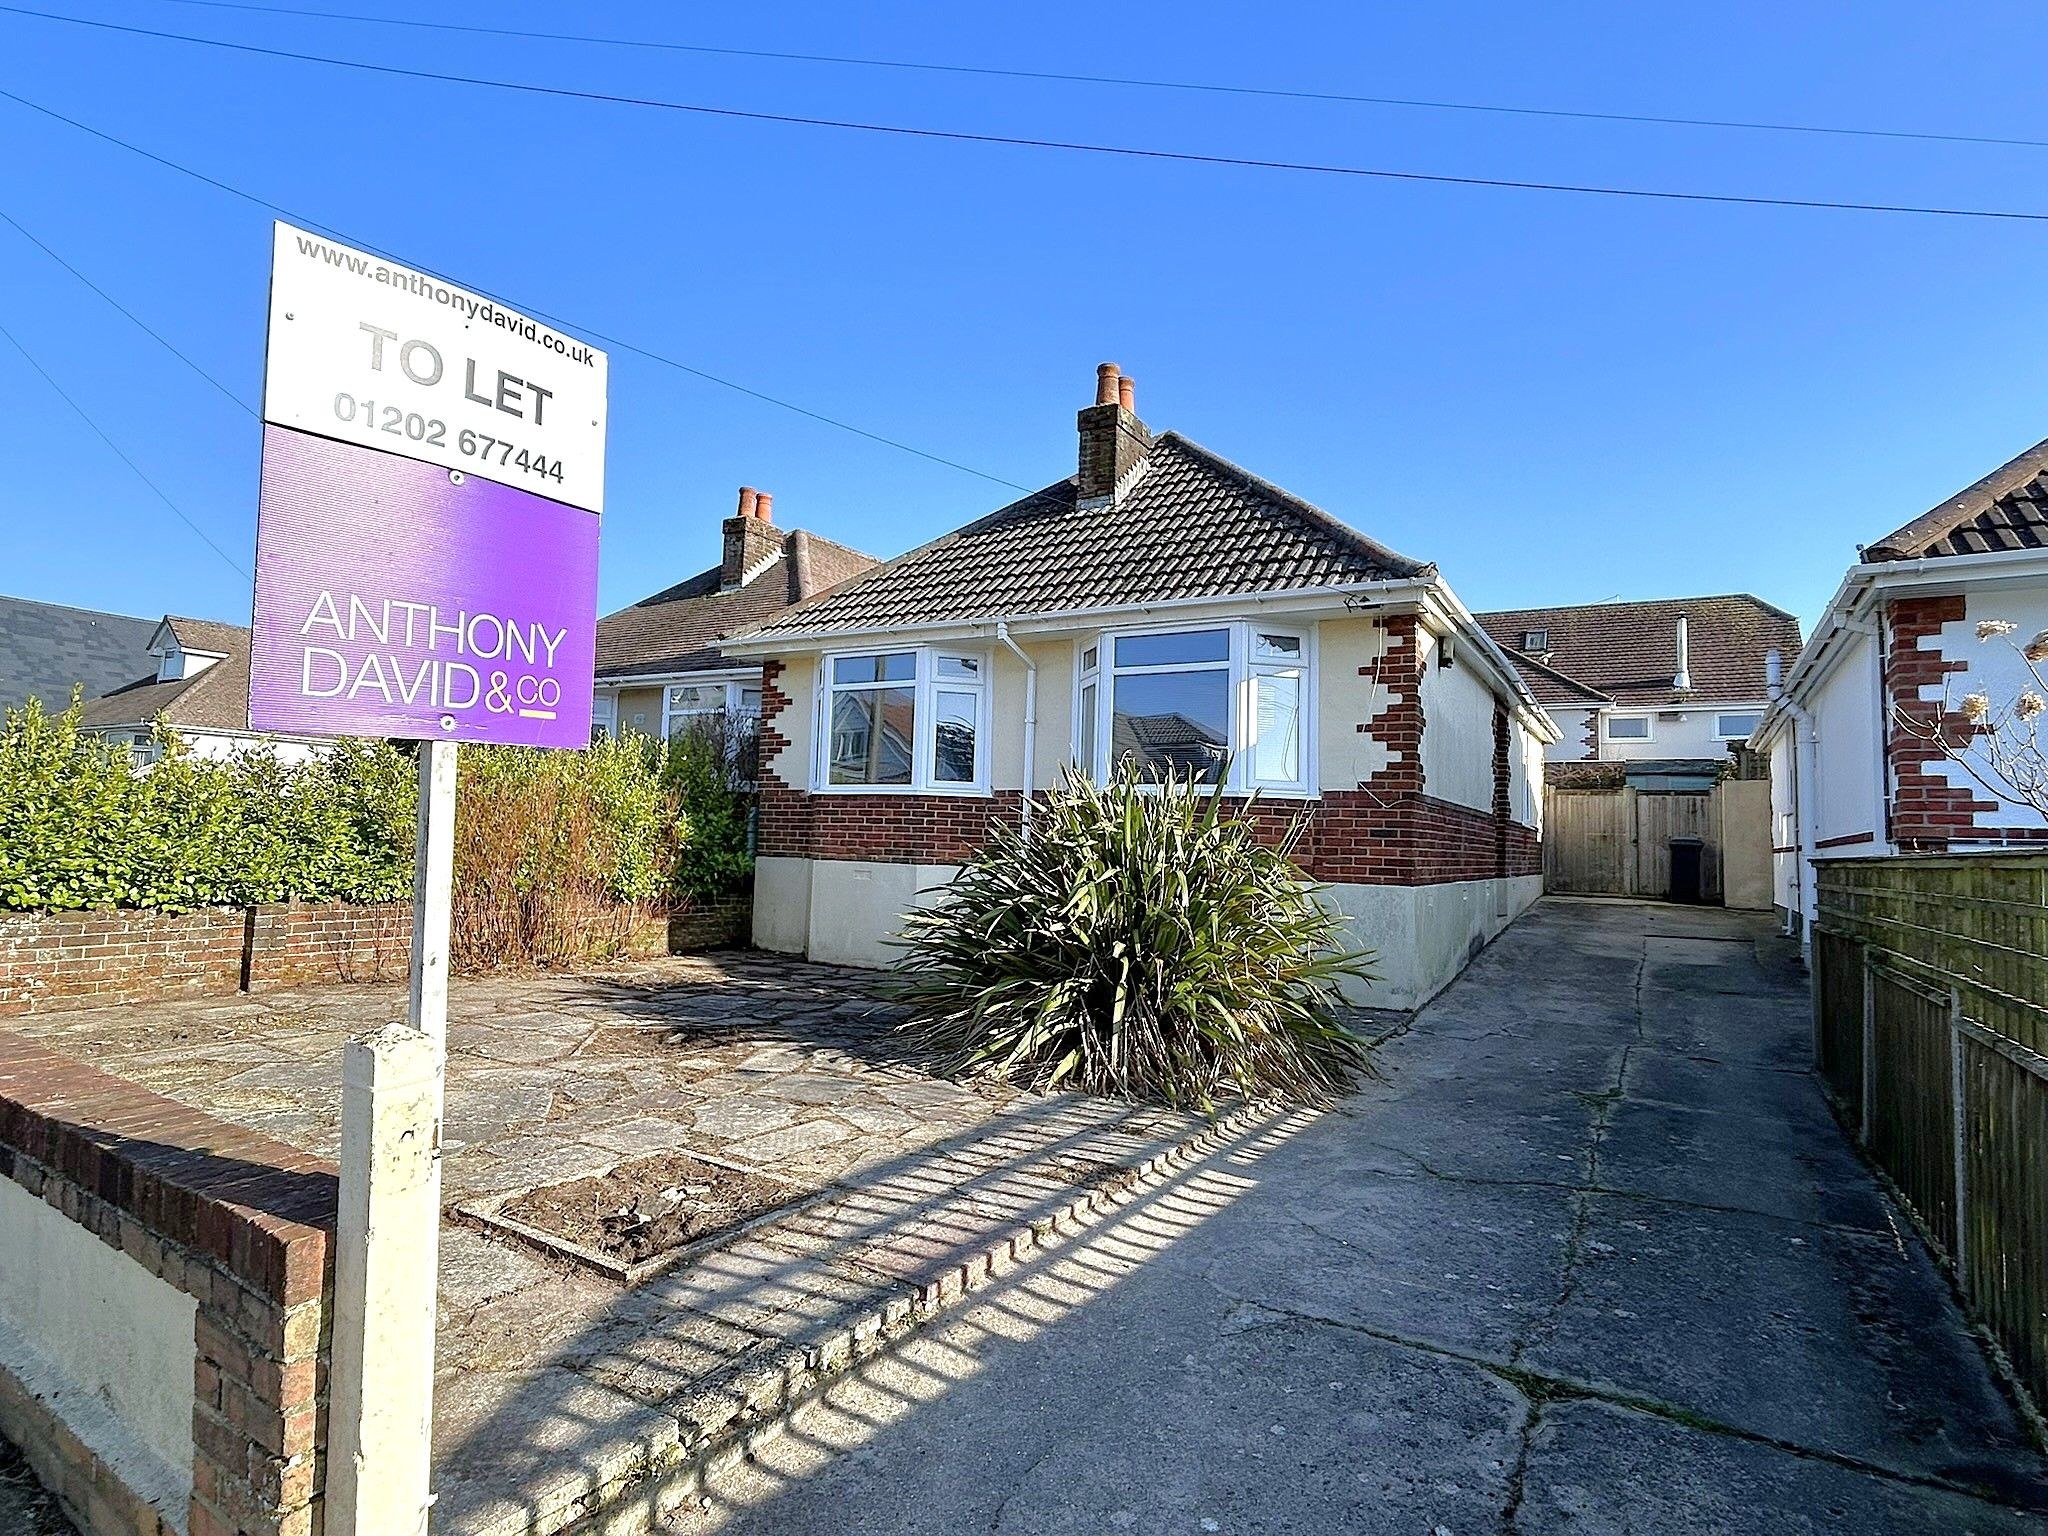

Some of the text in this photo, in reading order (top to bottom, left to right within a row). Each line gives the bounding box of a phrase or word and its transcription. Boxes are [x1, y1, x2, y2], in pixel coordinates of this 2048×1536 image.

[296, 235, 594, 368] www.anthonydavid.co.uk
[359, 321, 553, 426] TO LET
[334, 392, 565, 485] 01202 677444
[300, 590, 568, 668] ANTHONY
